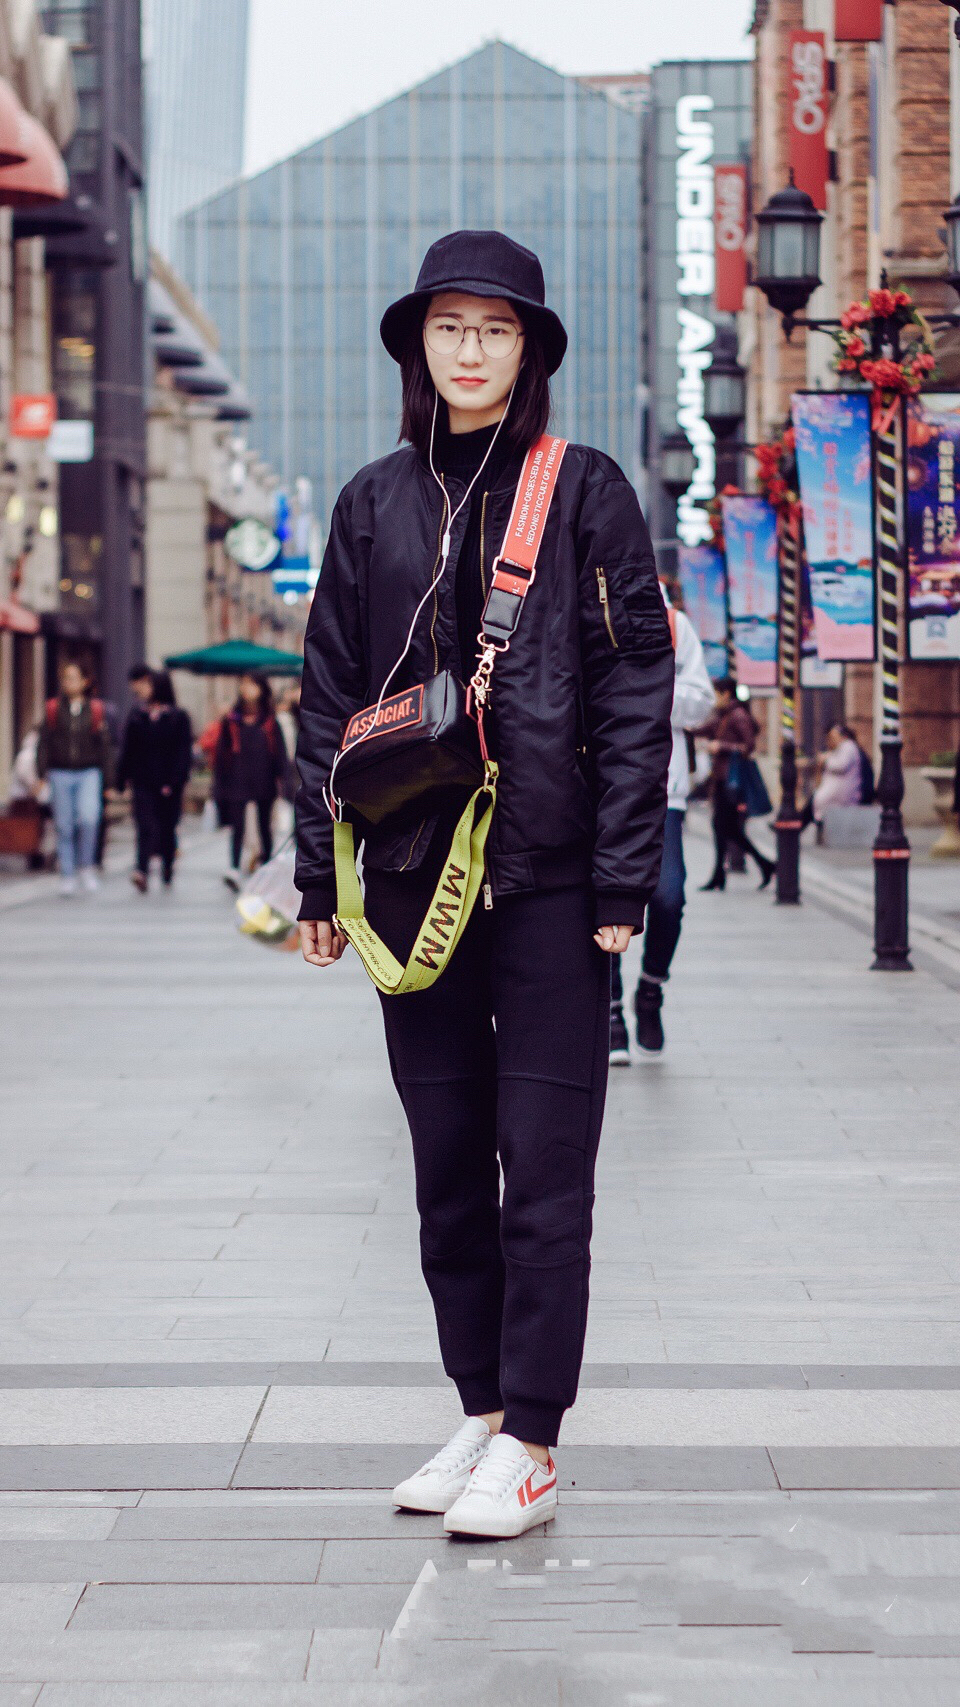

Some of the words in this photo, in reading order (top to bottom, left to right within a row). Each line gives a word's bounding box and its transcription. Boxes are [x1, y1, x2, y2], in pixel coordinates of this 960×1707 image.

[676, 95, 715, 296] UNDER
[515, 465, 540, 537] FASHION-OBSESSED
[533, 450, 544, 466] AND
[349, 697, 415, 738] ASSOCIAT.
[415, 863, 466, 970] MWM
